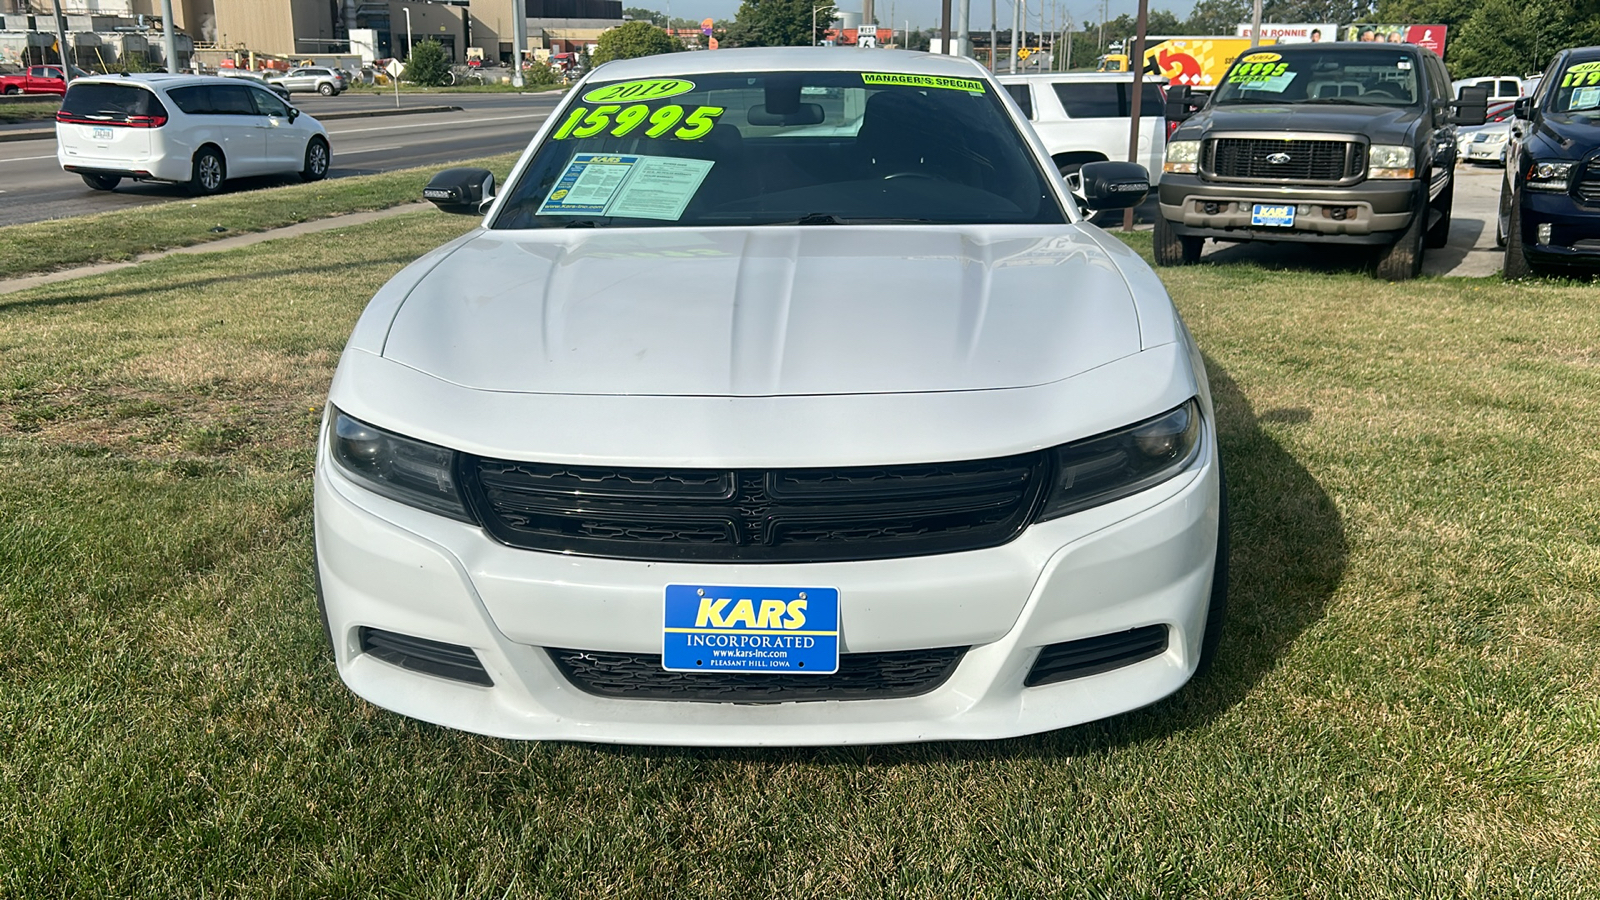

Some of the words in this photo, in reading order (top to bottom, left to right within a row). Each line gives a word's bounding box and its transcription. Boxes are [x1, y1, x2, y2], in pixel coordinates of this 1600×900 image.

[860, 26, 875, 34] WEST
[1242, 29, 1267, 37] EVN
[1271, 29, 1307, 37] RONNIE
[1228, 62, 1289, 77] 14995
[864, 74, 934, 85] MANAGER'S
[936, 78, 982, 90] SPECIAL
[600, 81, 679, 100] 2019
[552, 104, 724, 140] 15995
[694, 597, 808, 630] KARS
[687, 634, 815, 649] INCORPORATED
